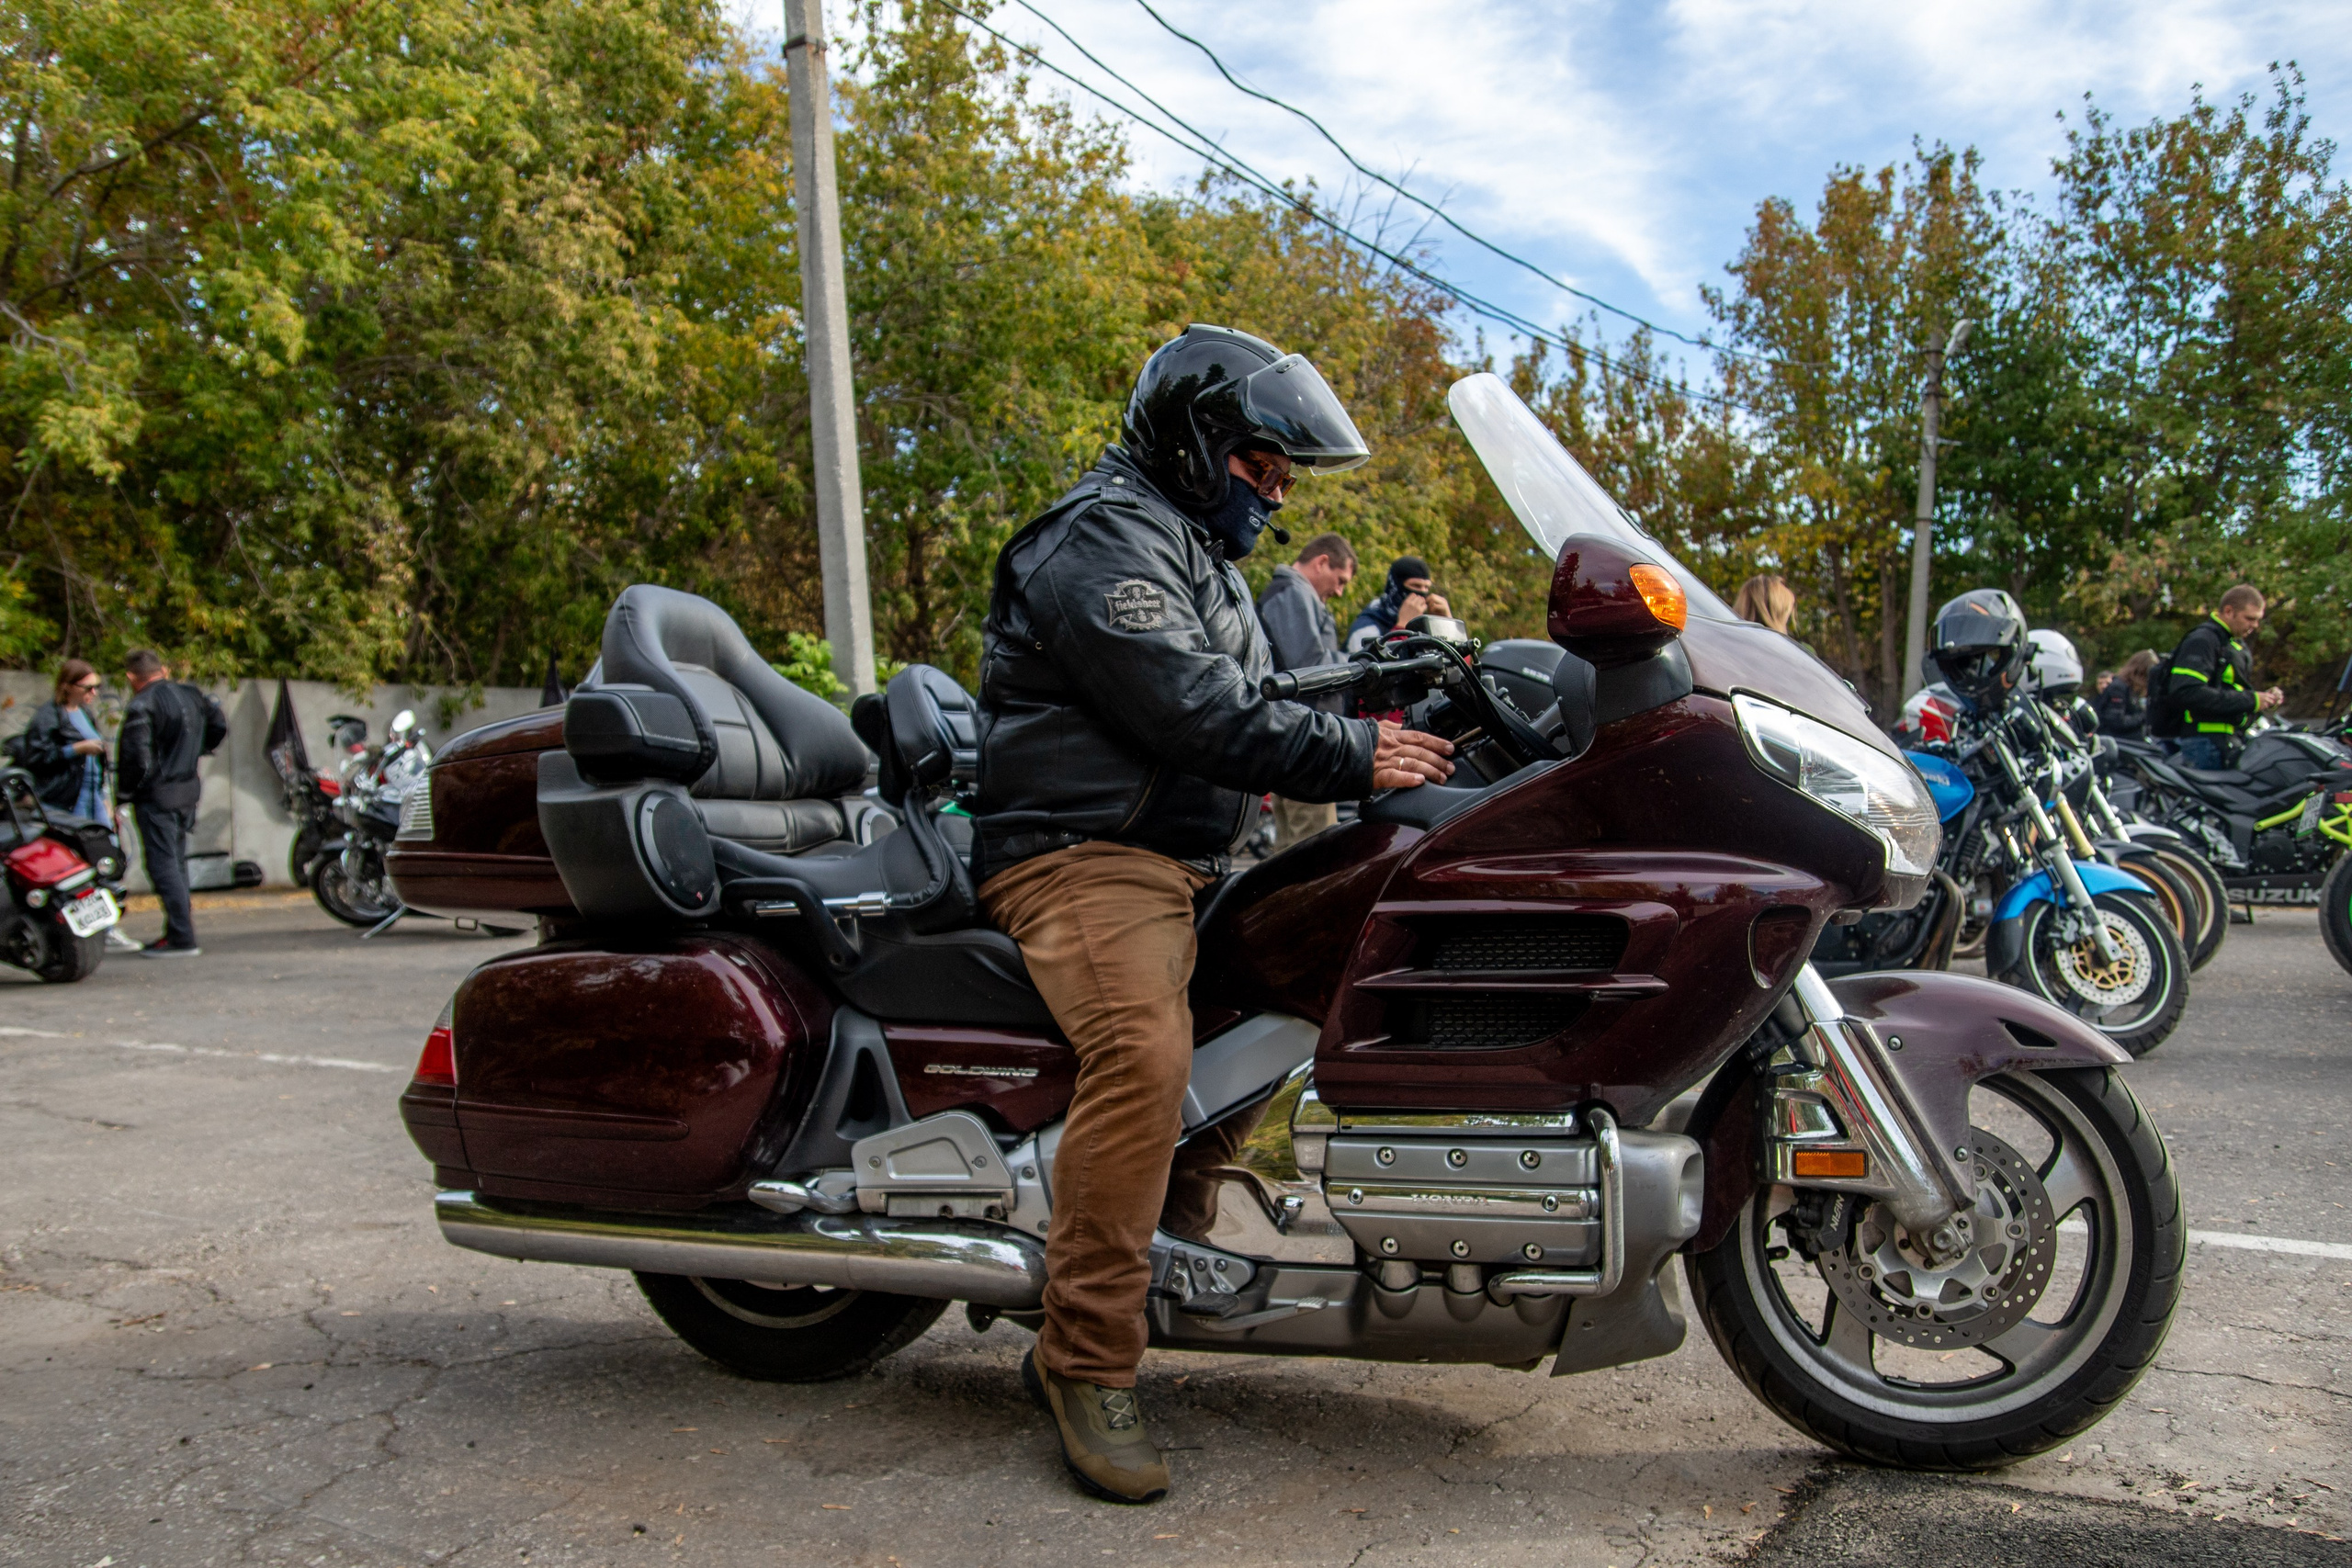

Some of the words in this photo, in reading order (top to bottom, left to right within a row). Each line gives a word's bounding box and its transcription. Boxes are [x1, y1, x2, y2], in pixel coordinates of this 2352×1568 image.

[1114, 598, 1160, 612] fieldsheer
[2227, 887, 2323, 903] SUZUK
[1411, 1193, 1490, 1206] HONDA
